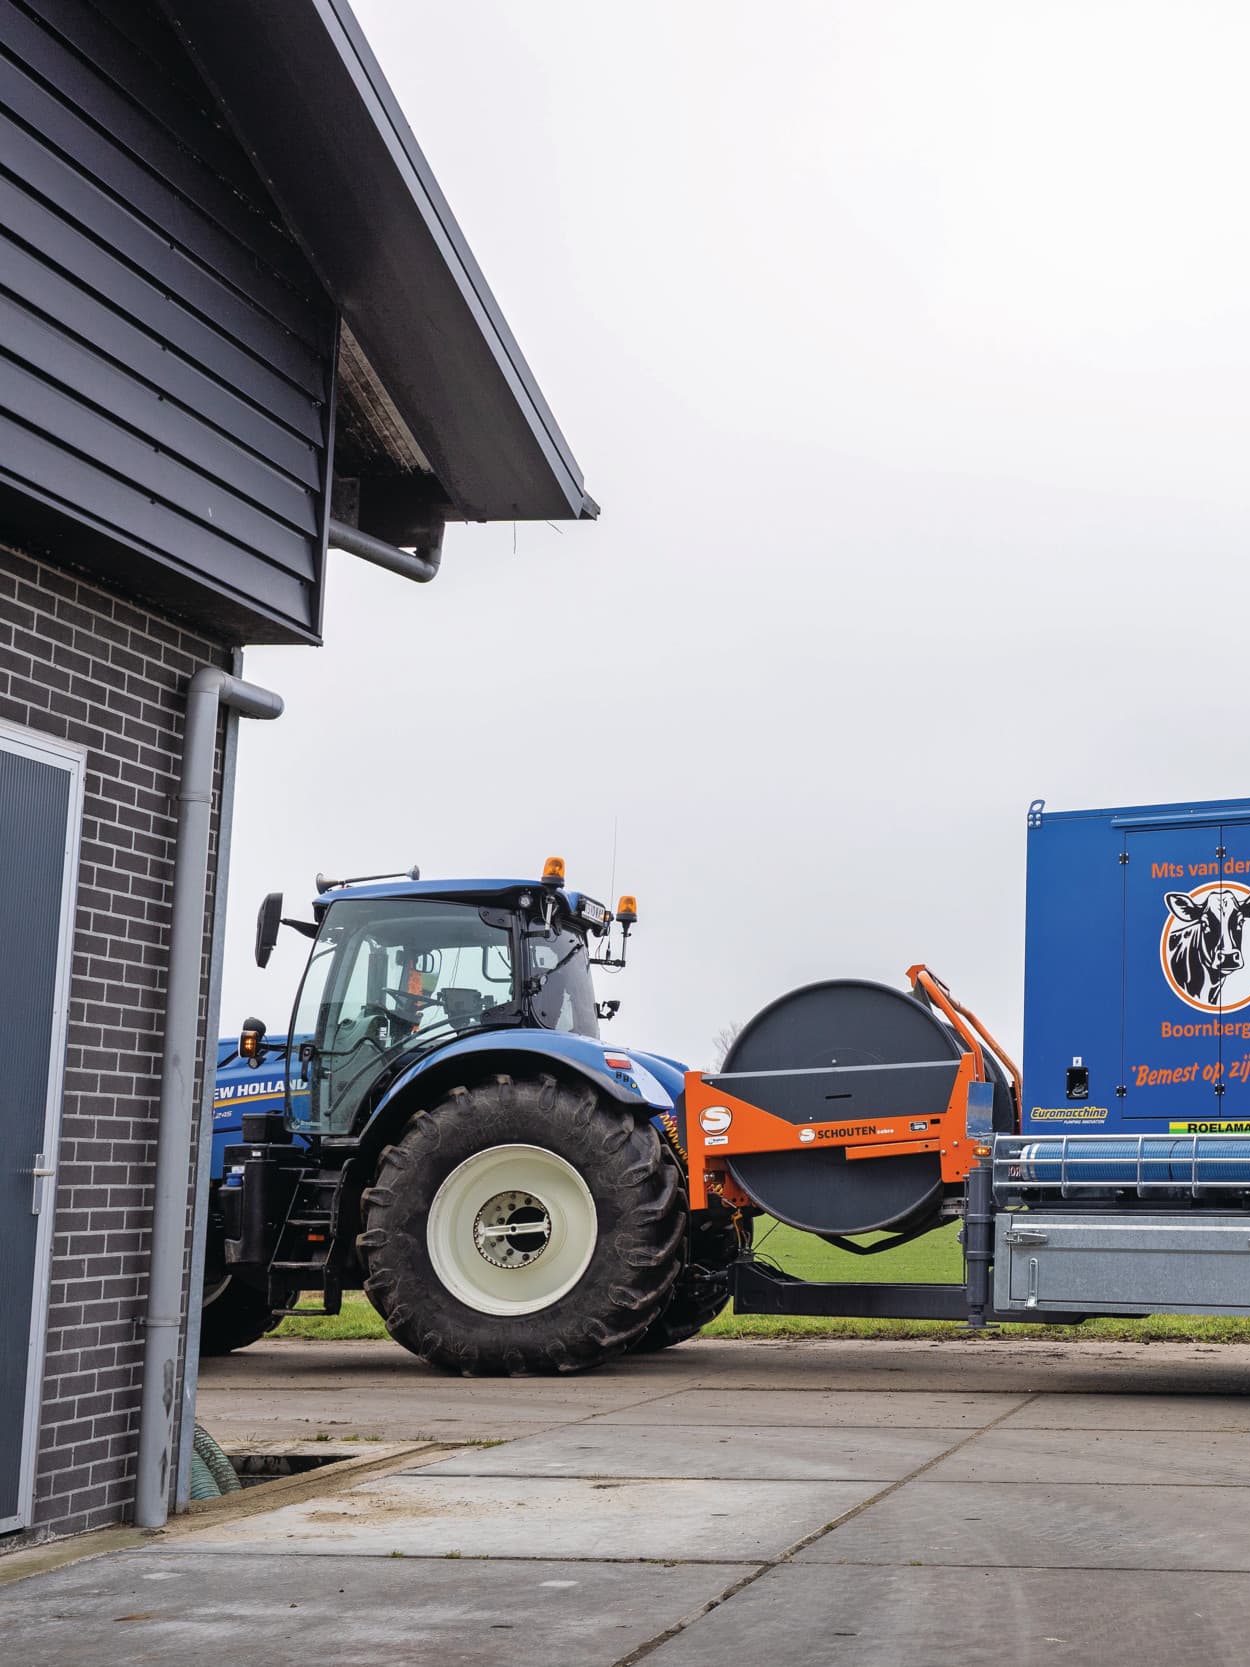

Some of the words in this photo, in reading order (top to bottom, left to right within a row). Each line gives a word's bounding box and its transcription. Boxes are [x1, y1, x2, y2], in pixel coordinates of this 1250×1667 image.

[1151, 862, 1184, 878] Mts
[1188, 862, 1219, 876] van
[1202, 1062, 1224, 1084] op
[214, 1086, 234, 1099] EW
[237, 1079, 308, 1096] HOLLAND
[1031, 1106, 1108, 1119] Euromacchine
[817, 1126, 877, 1139] SCHOUTEN
